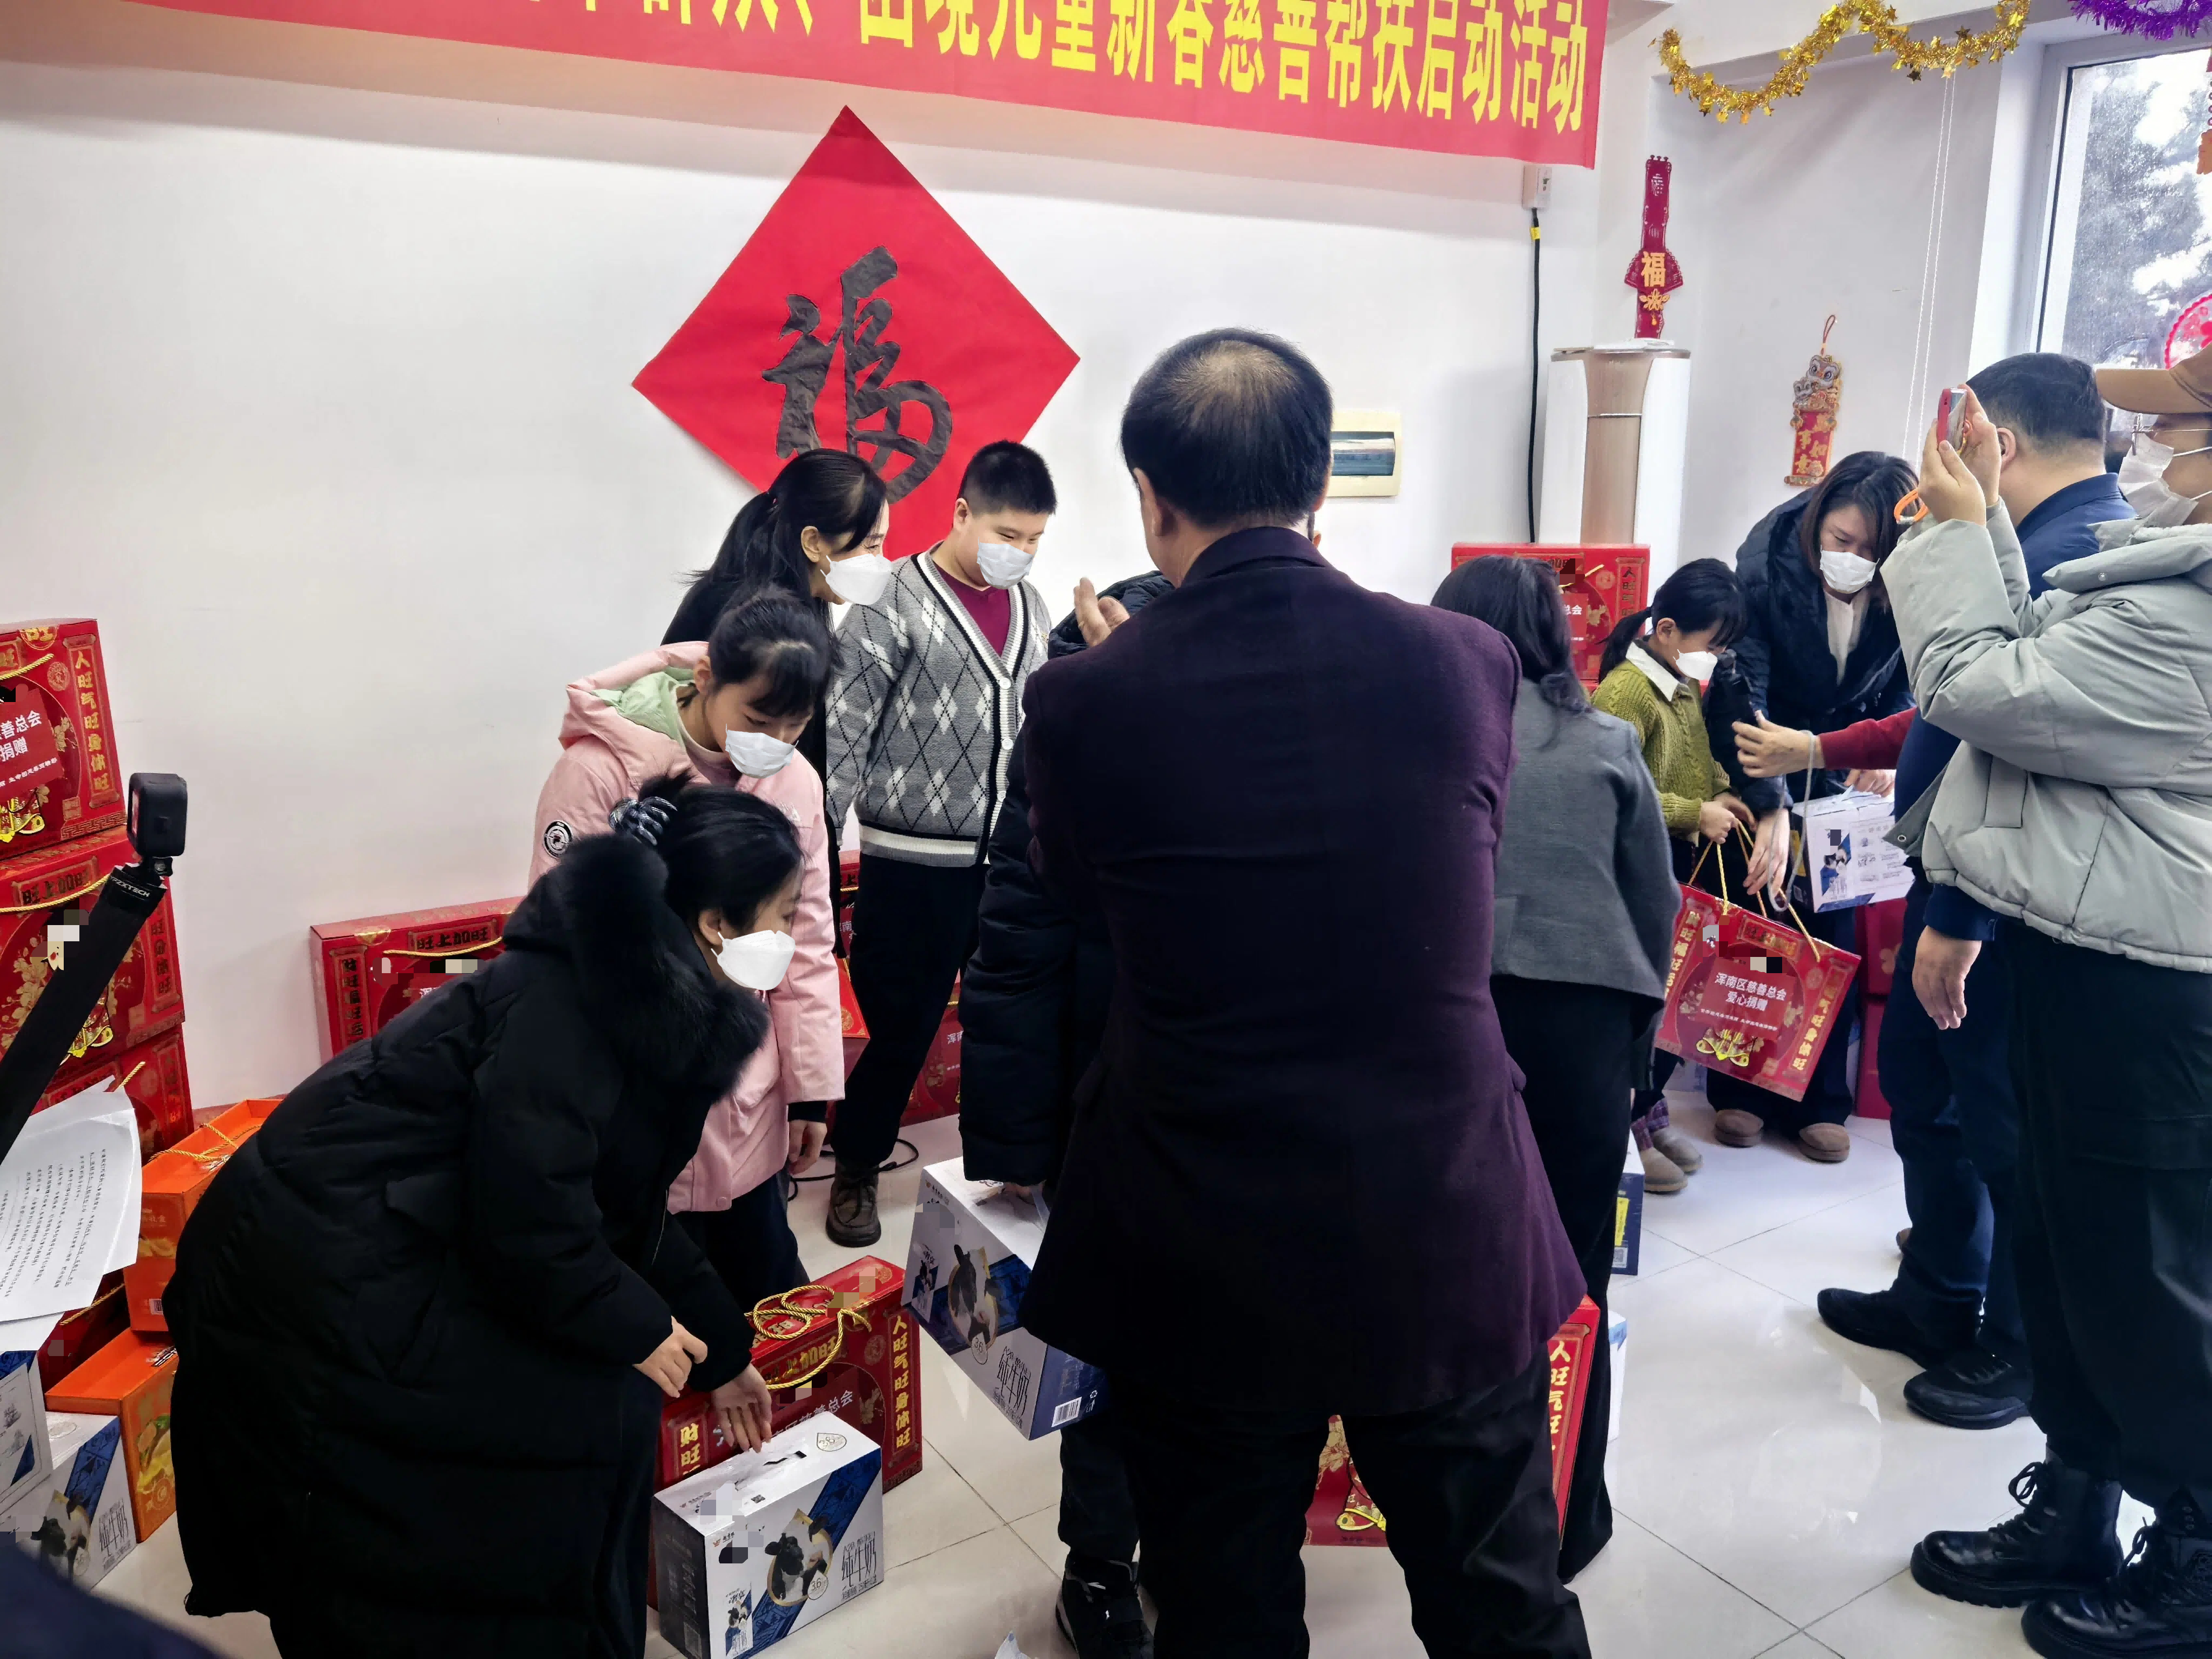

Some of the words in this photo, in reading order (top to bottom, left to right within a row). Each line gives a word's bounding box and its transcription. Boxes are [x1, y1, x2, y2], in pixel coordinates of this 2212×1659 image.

[1641, 251, 1665, 287] 福
[761, 246, 953, 504] 福
[1715, 972, 1787, 1001] 浑南区慈善总会
[1725, 991, 1769, 1011] 爱心捐赠
[680, 1422, 701, 1475] 财旺
